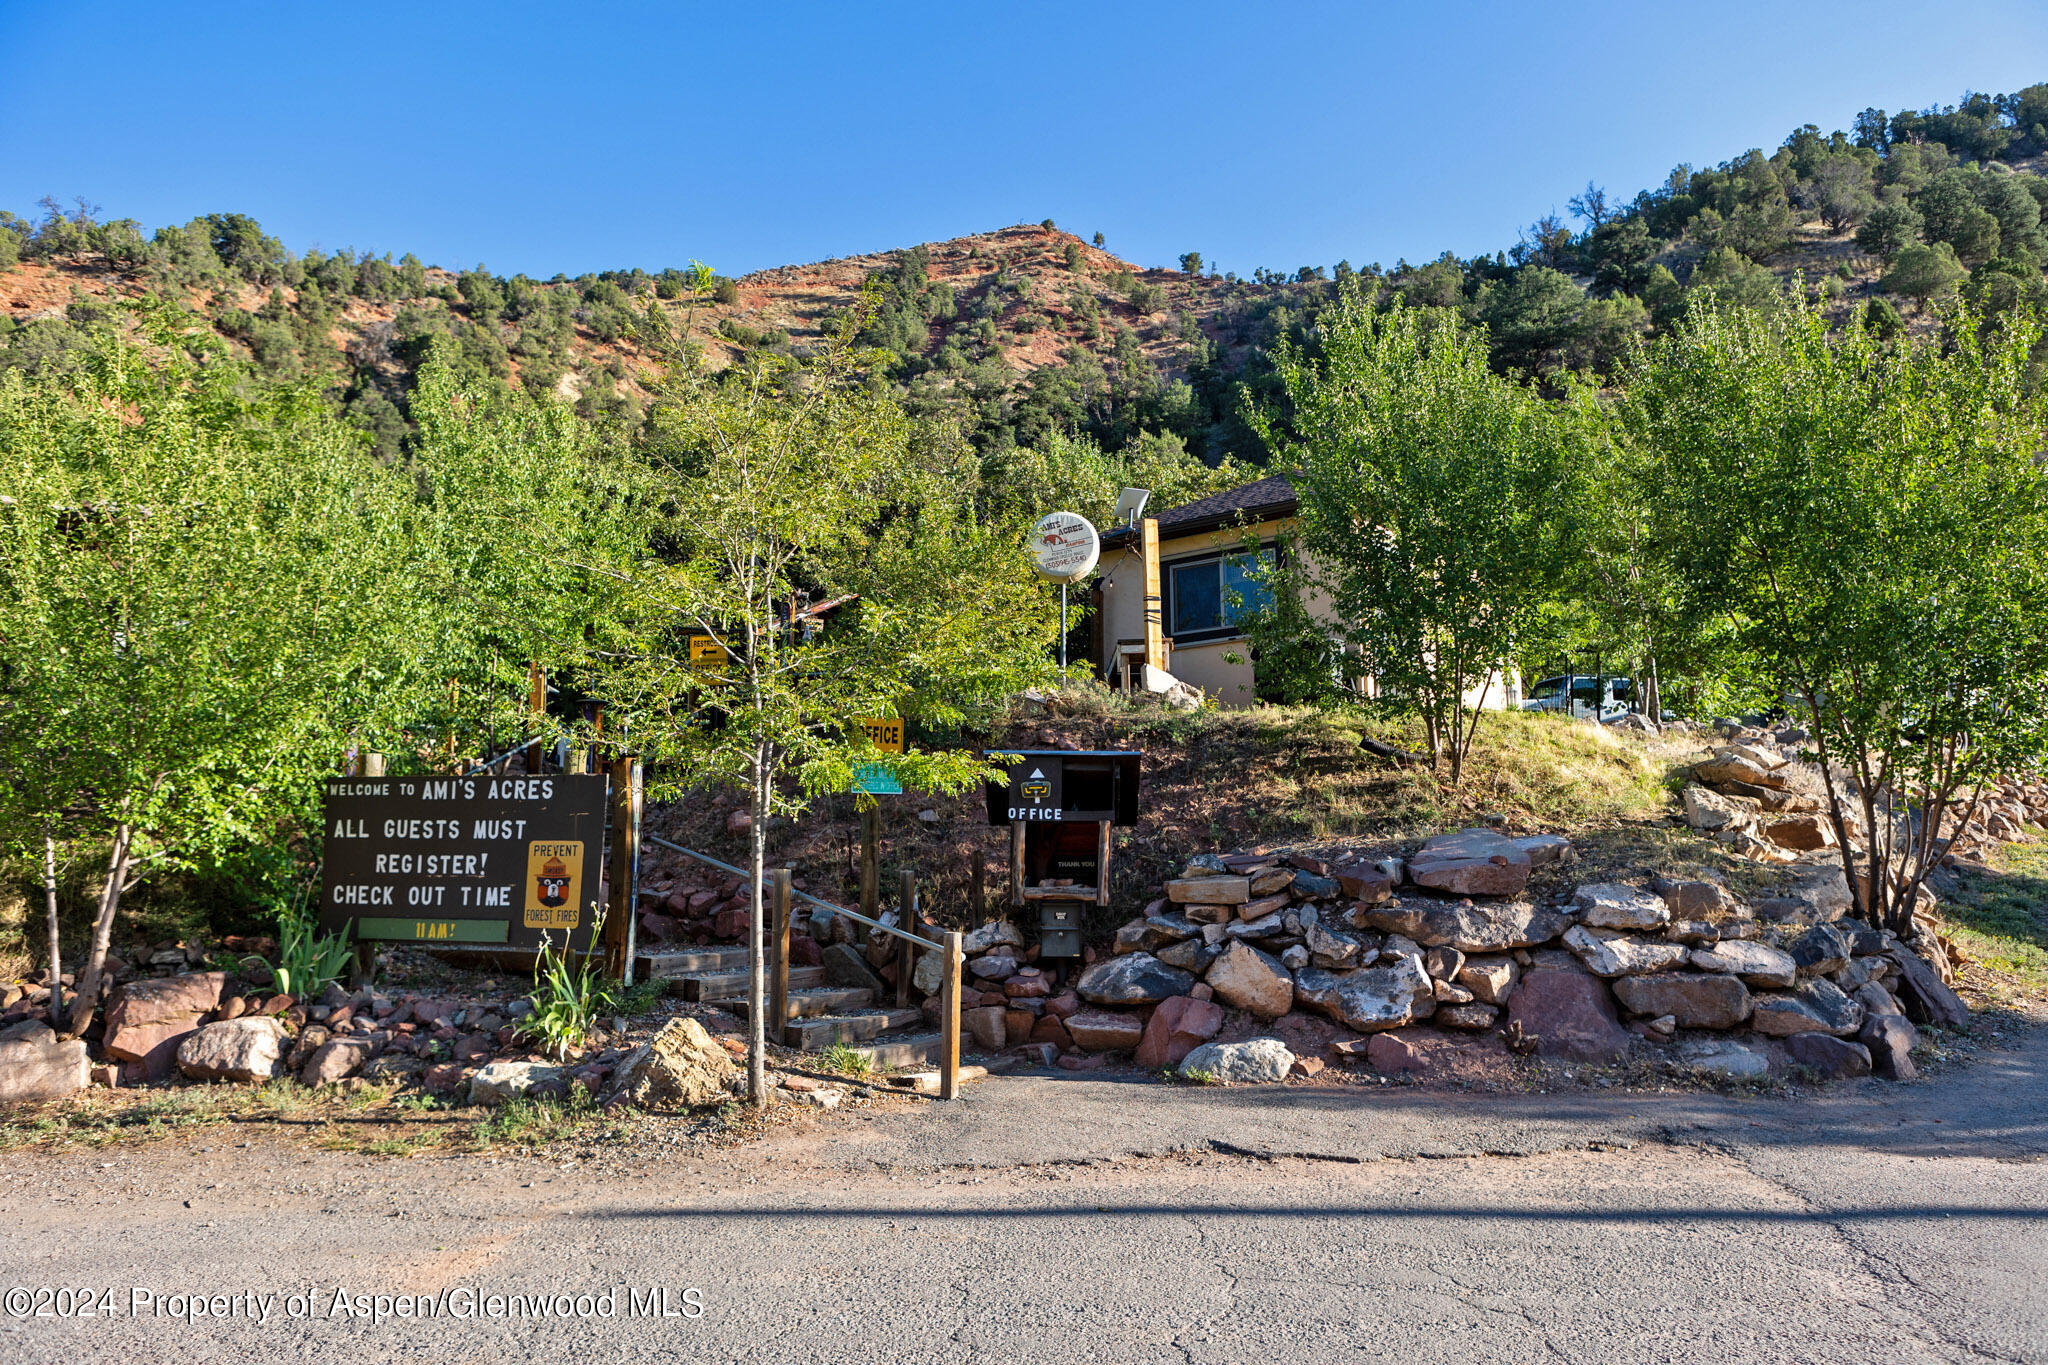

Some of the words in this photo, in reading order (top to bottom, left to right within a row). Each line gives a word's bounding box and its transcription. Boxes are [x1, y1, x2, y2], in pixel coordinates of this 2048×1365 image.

[1042, 521, 1062, 532] AMI'S
[1059, 523, 1084, 536] ACRES
[860, 725, 899, 745] FFICE
[330, 783, 390, 796] WELCOME
[400, 783, 415, 796] TO
[422, 779, 475, 800] AMI'S
[488, 779, 553, 800] ACRES
[1008, 808, 1062, 820] OFFICE
[334, 819, 369, 838] ALL
[384, 819, 460, 840] GUESTS
[473, 820, 527, 840] MUST
[533, 844, 579, 857] PREVENT
[376, 853, 488, 875] REGISTER!
[333, 885, 393, 905] CHECK
[408, 886, 444, 906] OUT
[461, 886, 511, 907] TIME
[526, 910, 552, 924] FOREST
[556, 910, 578, 923] FIRES
[416, 922, 425, 938] 11
[428, 922, 455, 939] AM!
